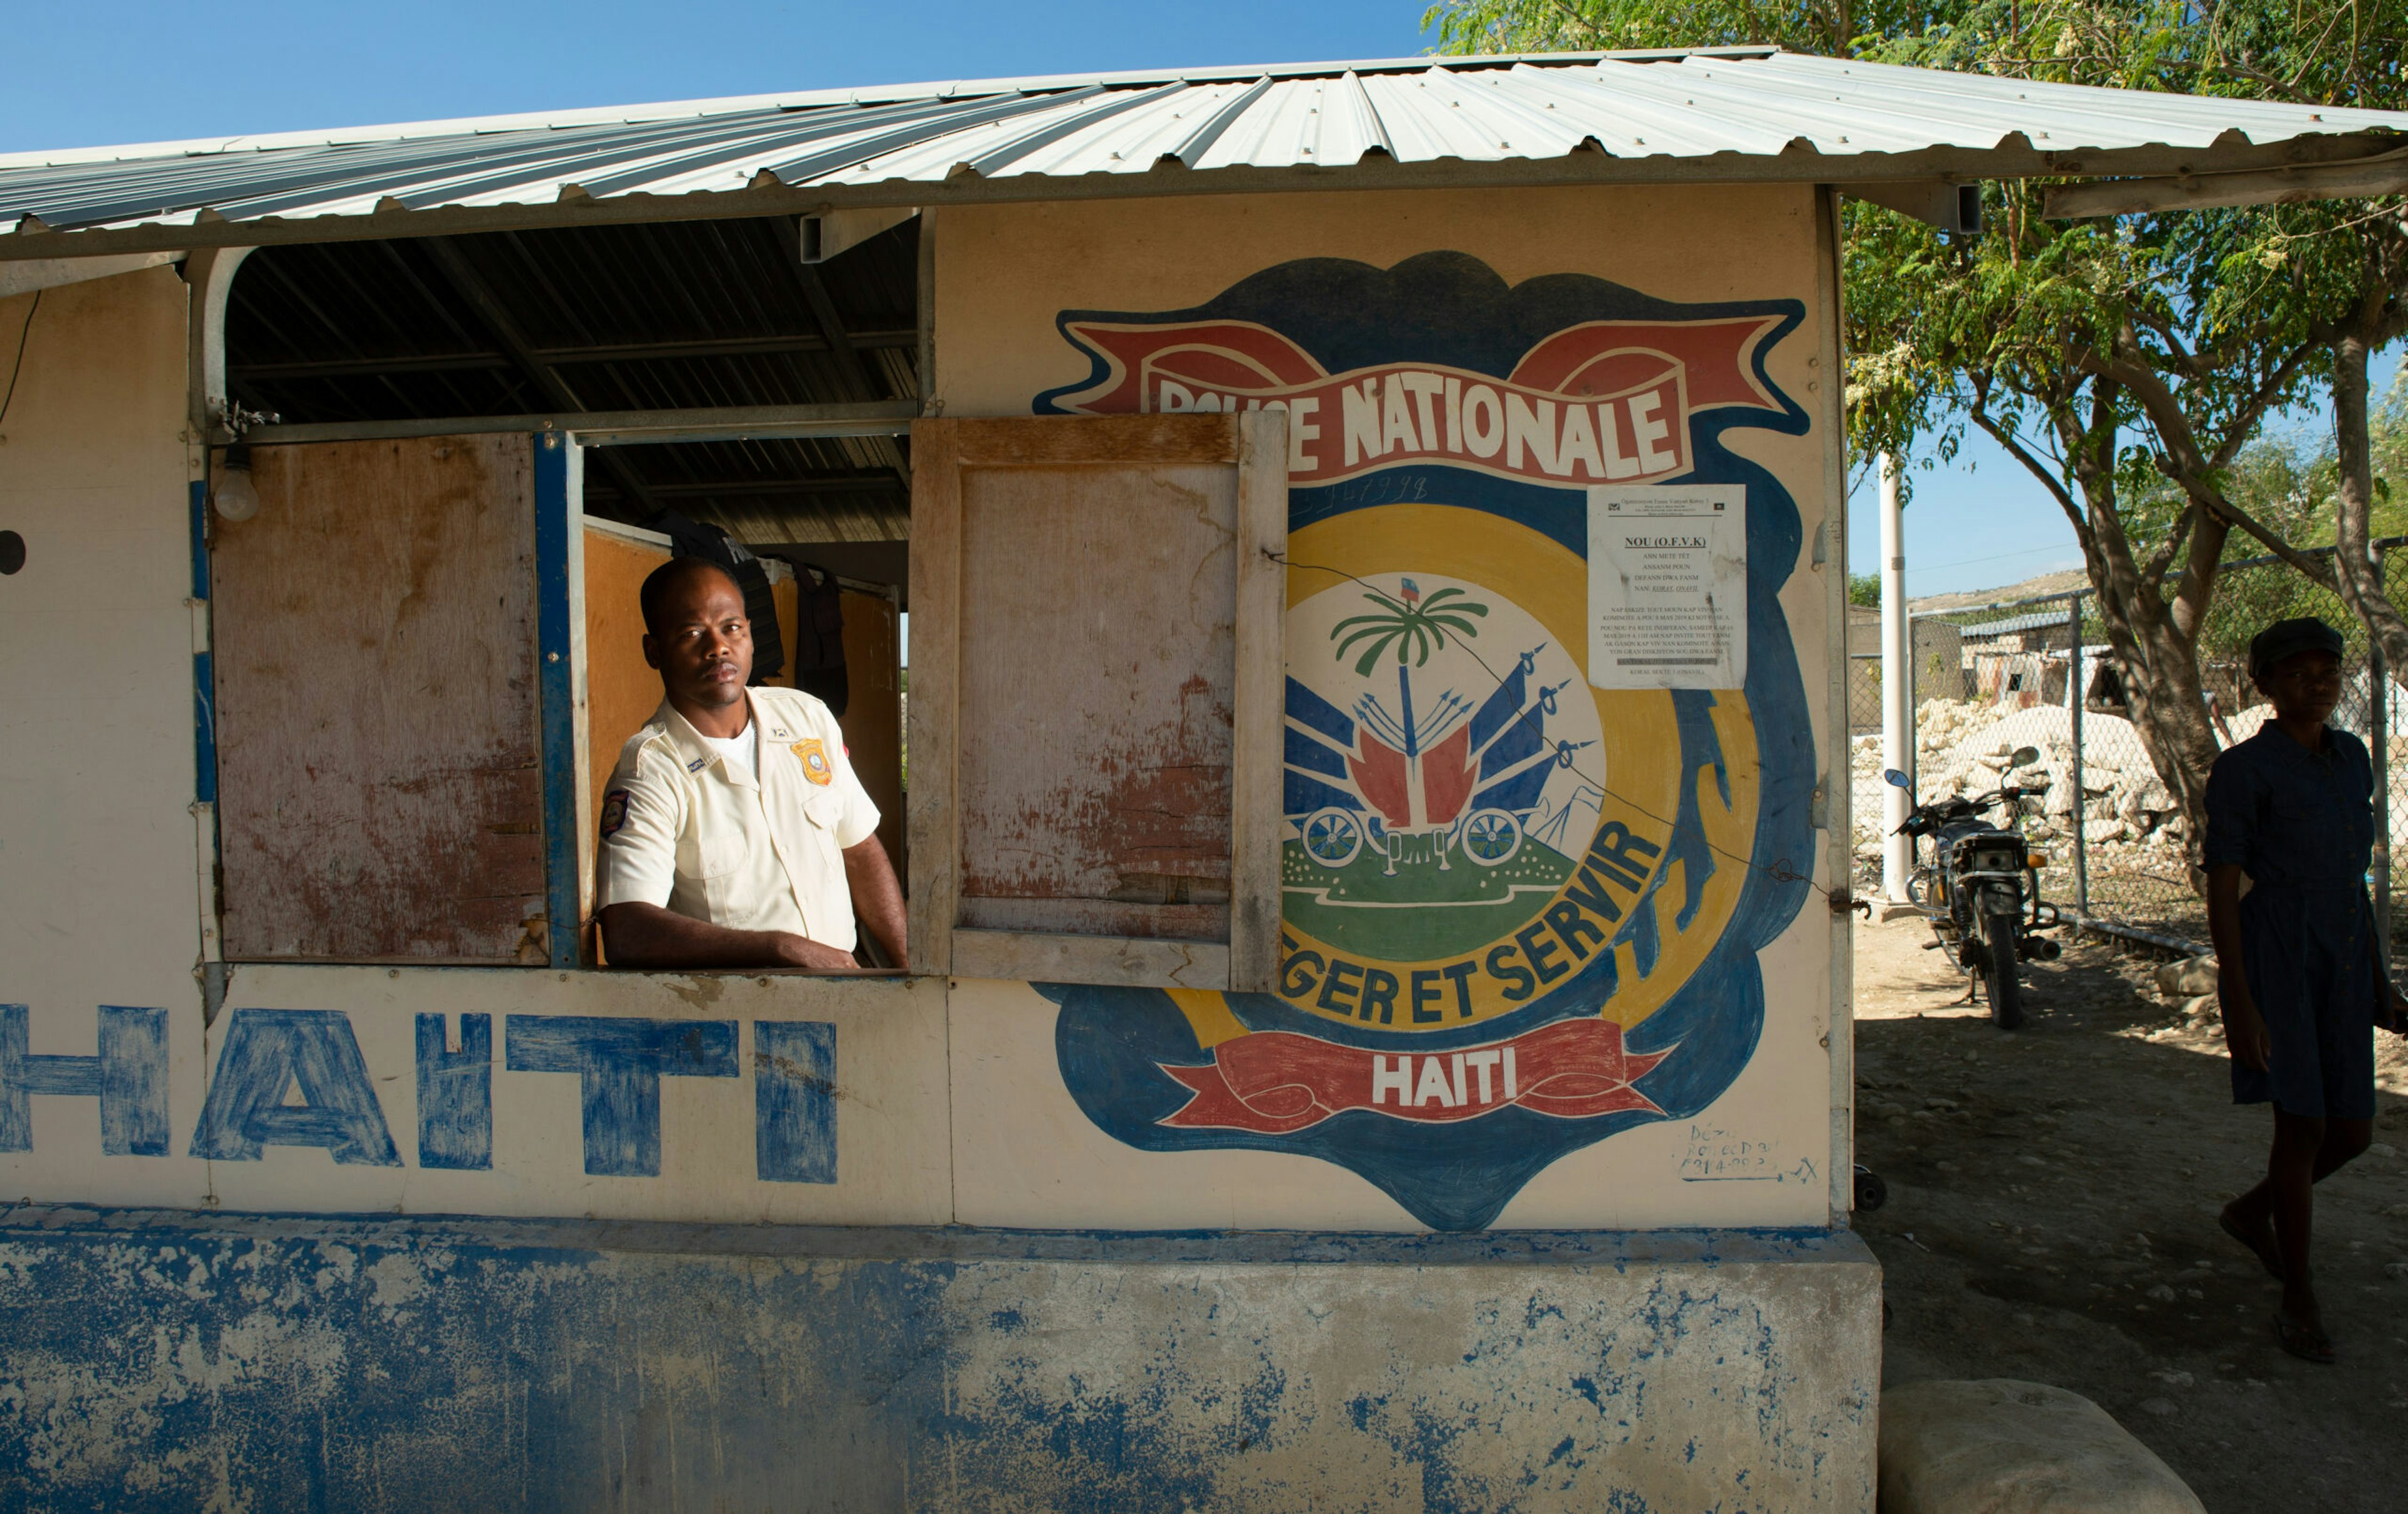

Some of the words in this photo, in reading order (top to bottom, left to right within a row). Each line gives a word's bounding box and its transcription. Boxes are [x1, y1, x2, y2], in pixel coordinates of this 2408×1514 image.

[1341, 371, 1677, 480] NATIONALE
[1625, 537, 1651, 548] NOU
[1654, 537, 1706, 548] (O.F.V.K)
[1410, 960, 1478, 1024] ET
[1485, 820, 1662, 1002] SERVIR
[1372, 1046, 1517, 1108] HAITI
